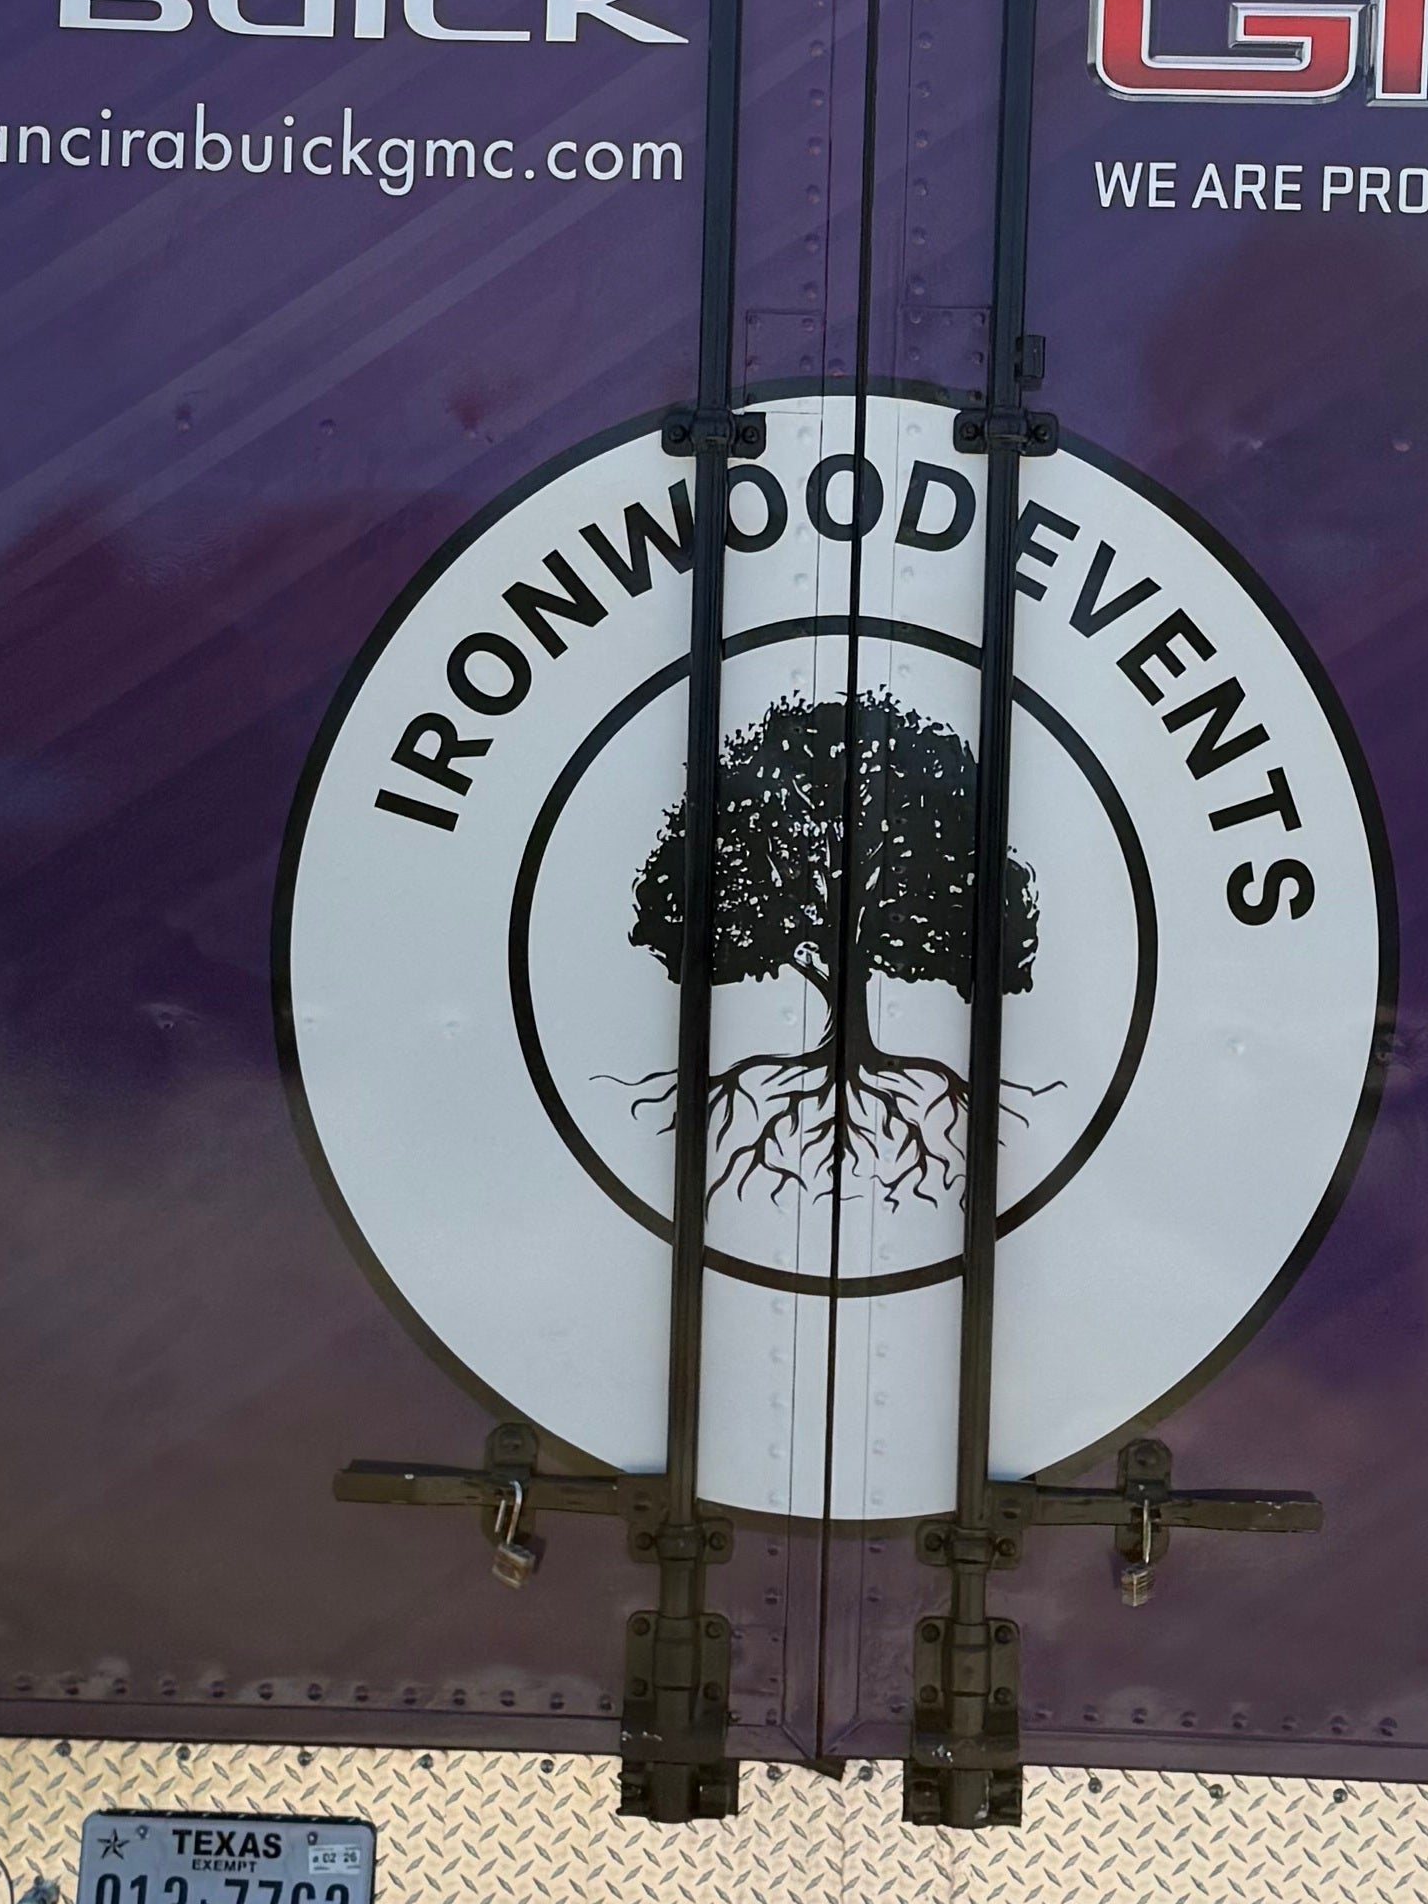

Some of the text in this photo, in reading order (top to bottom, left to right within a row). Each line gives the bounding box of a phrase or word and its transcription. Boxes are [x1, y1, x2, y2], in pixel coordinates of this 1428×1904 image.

[1094, 161, 1177, 208] WE
[1191, 163, 1303, 211] ARE
[374, 453, 1315, 927] IRONWOOD EVENTS
[172, 1829, 282, 1859] TEXAS
[192, 1859, 257, 1873] EXEMPT
